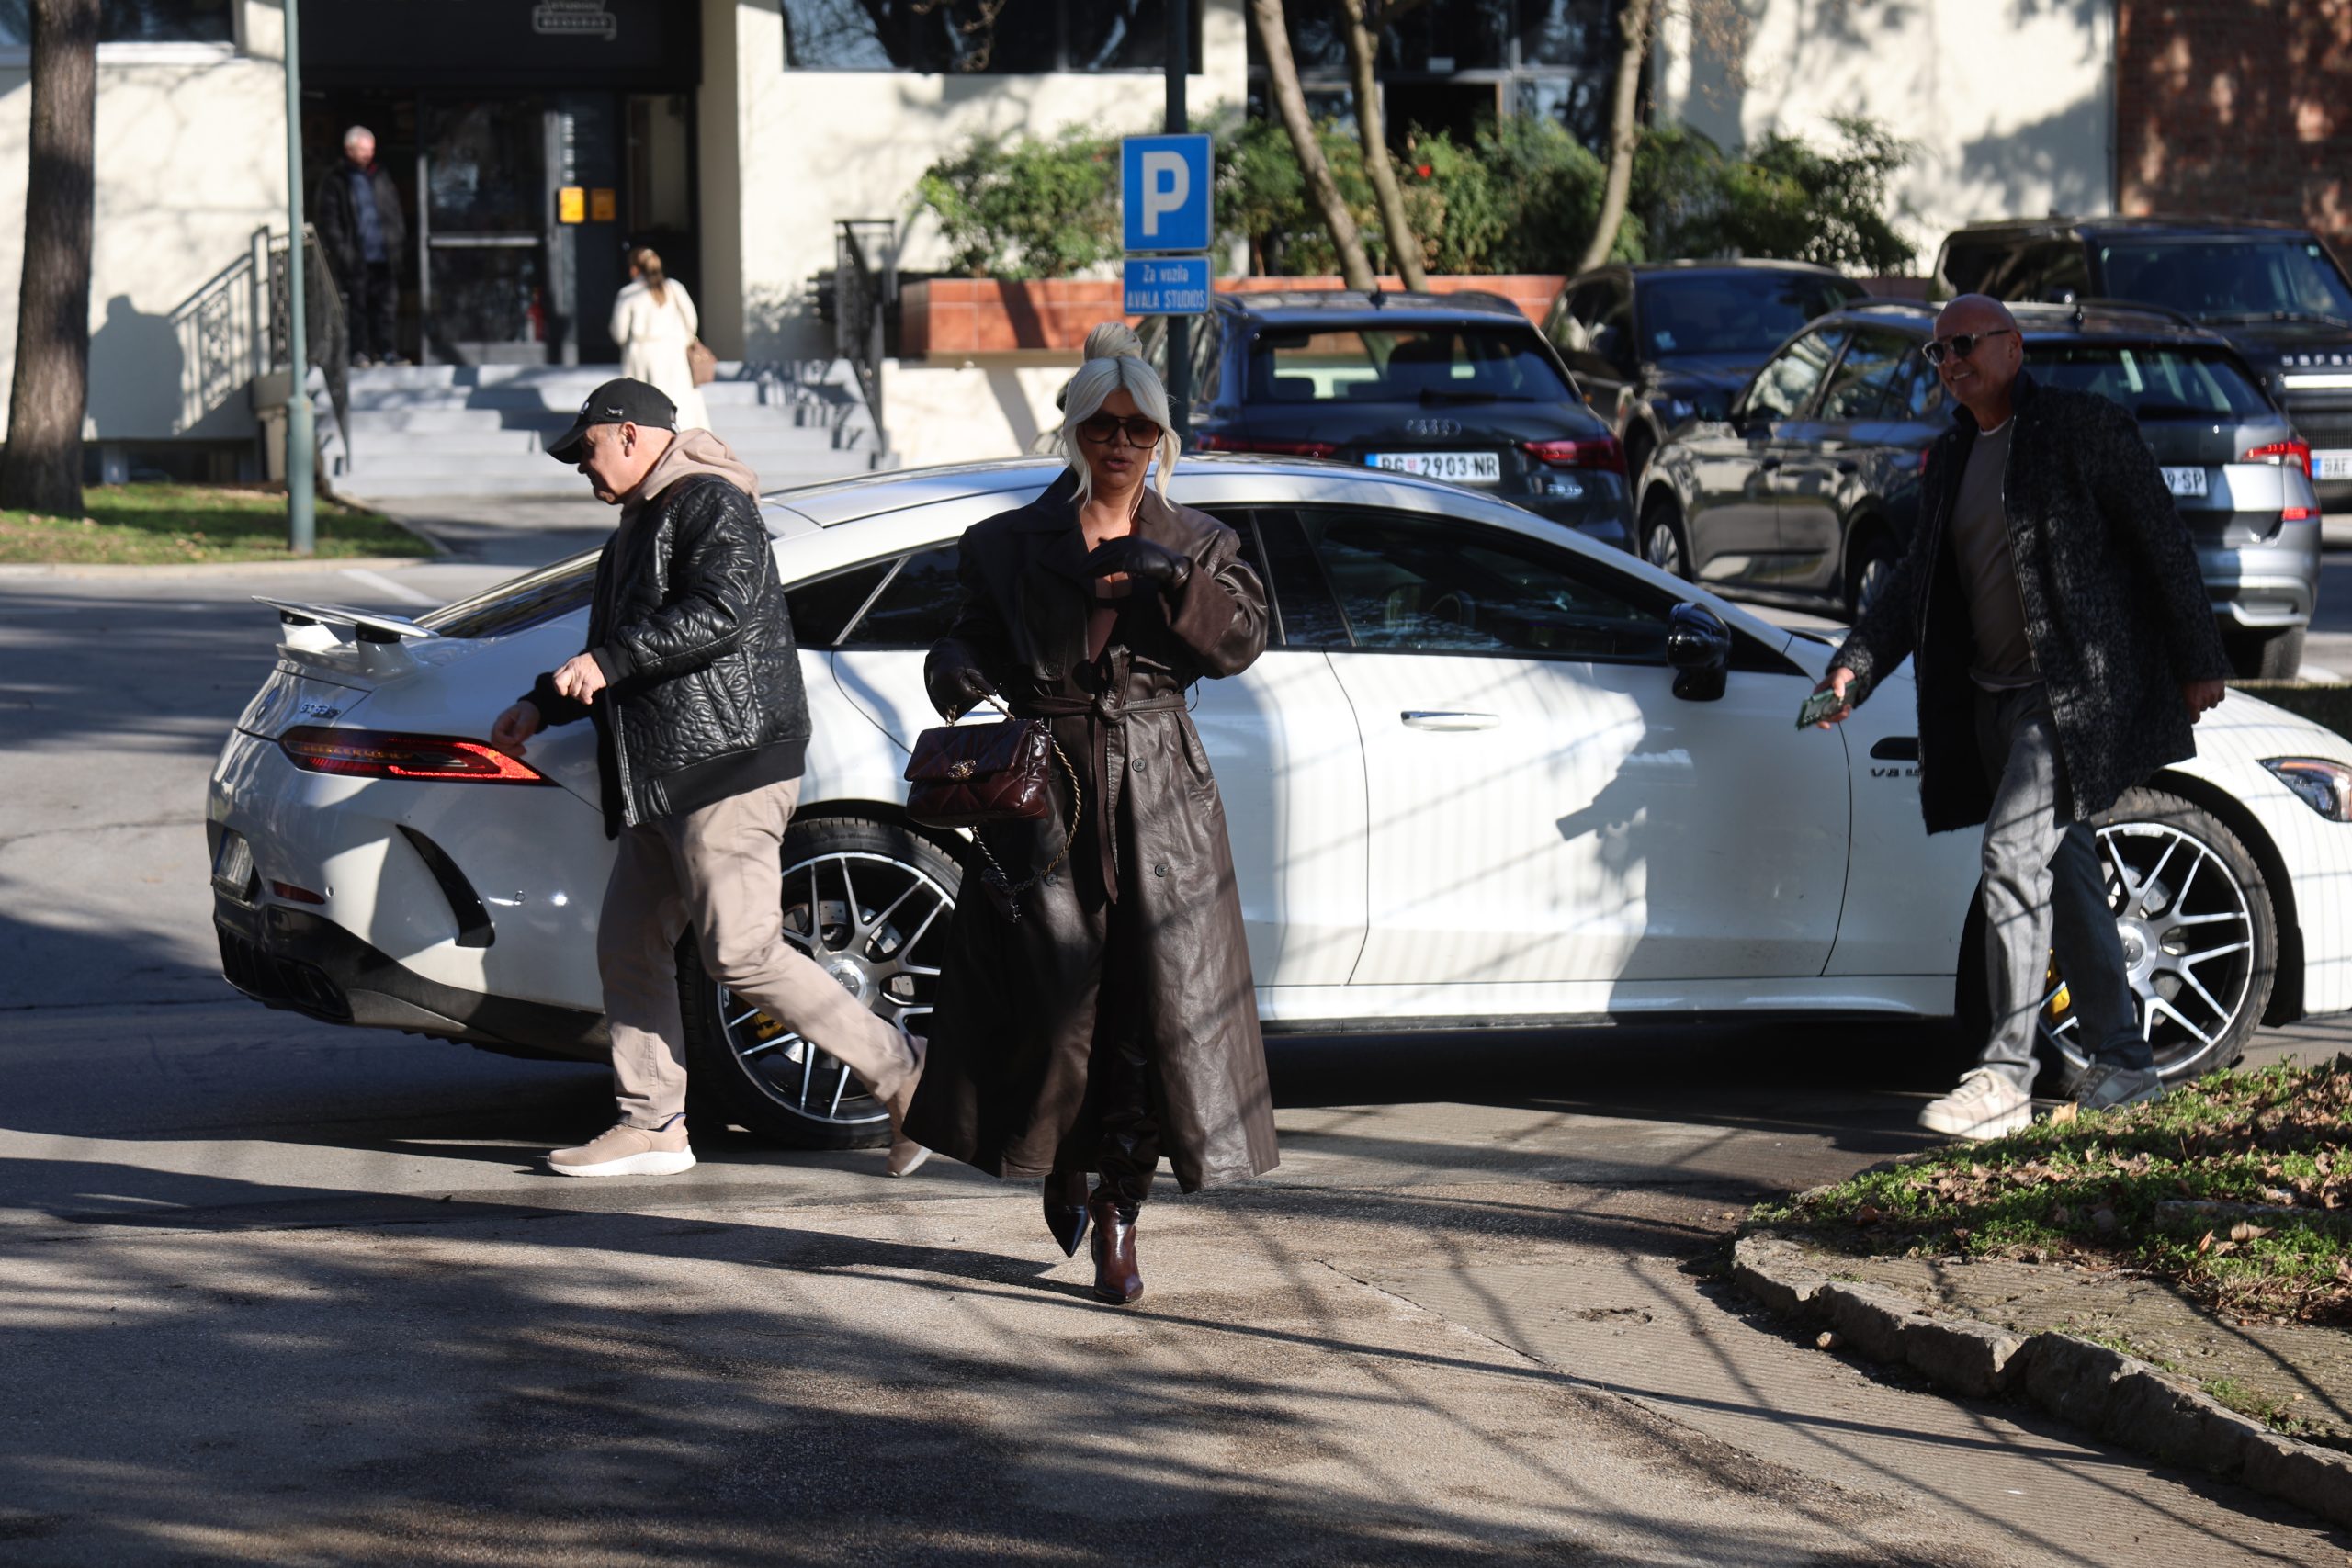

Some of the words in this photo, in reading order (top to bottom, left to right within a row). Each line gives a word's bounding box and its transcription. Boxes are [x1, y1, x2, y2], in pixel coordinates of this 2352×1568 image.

[1142, 151, 1190, 235] P
[1143, 264, 1156, 283] Za
[1160, 264, 1189, 282] vozila
[1127, 290, 1159, 309] AVALA
[1163, 289, 1206, 309] STUDIOS
